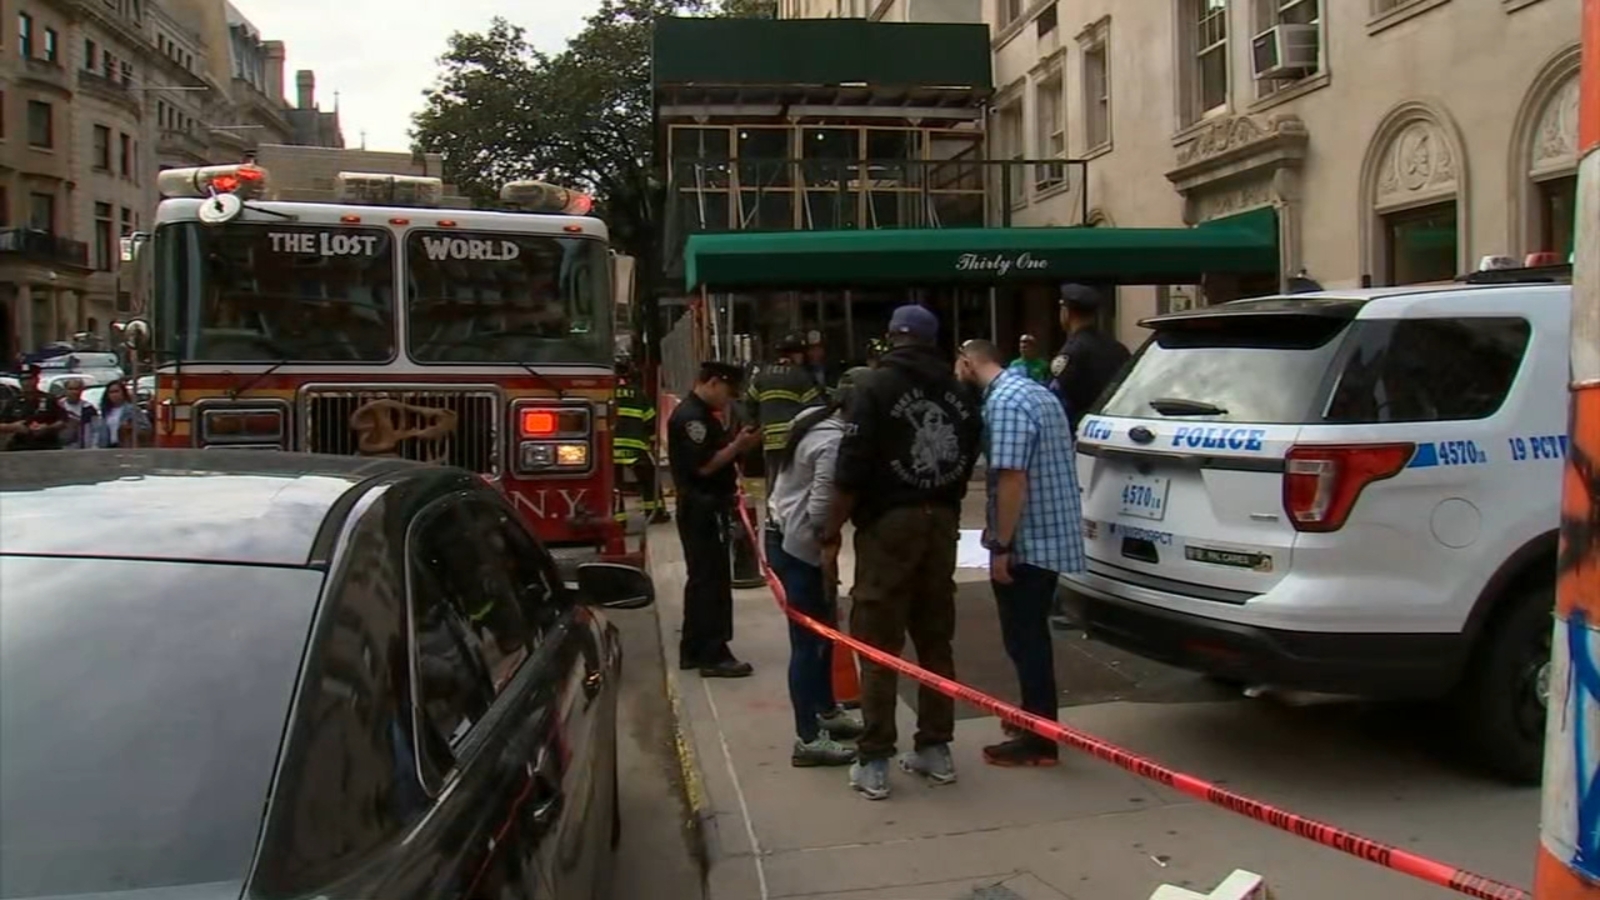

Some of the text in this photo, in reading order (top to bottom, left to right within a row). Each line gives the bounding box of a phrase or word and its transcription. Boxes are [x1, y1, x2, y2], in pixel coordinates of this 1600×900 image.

[268, 232, 520, 261] THE LOST WORLD
[955, 251, 1048, 276] Thirty One
[1171, 426, 1266, 451] POLICE
[1508, 435, 1560, 461] 19 PCT
[1438, 439, 1477, 466] 4570
[1121, 483, 1151, 506] 4570
